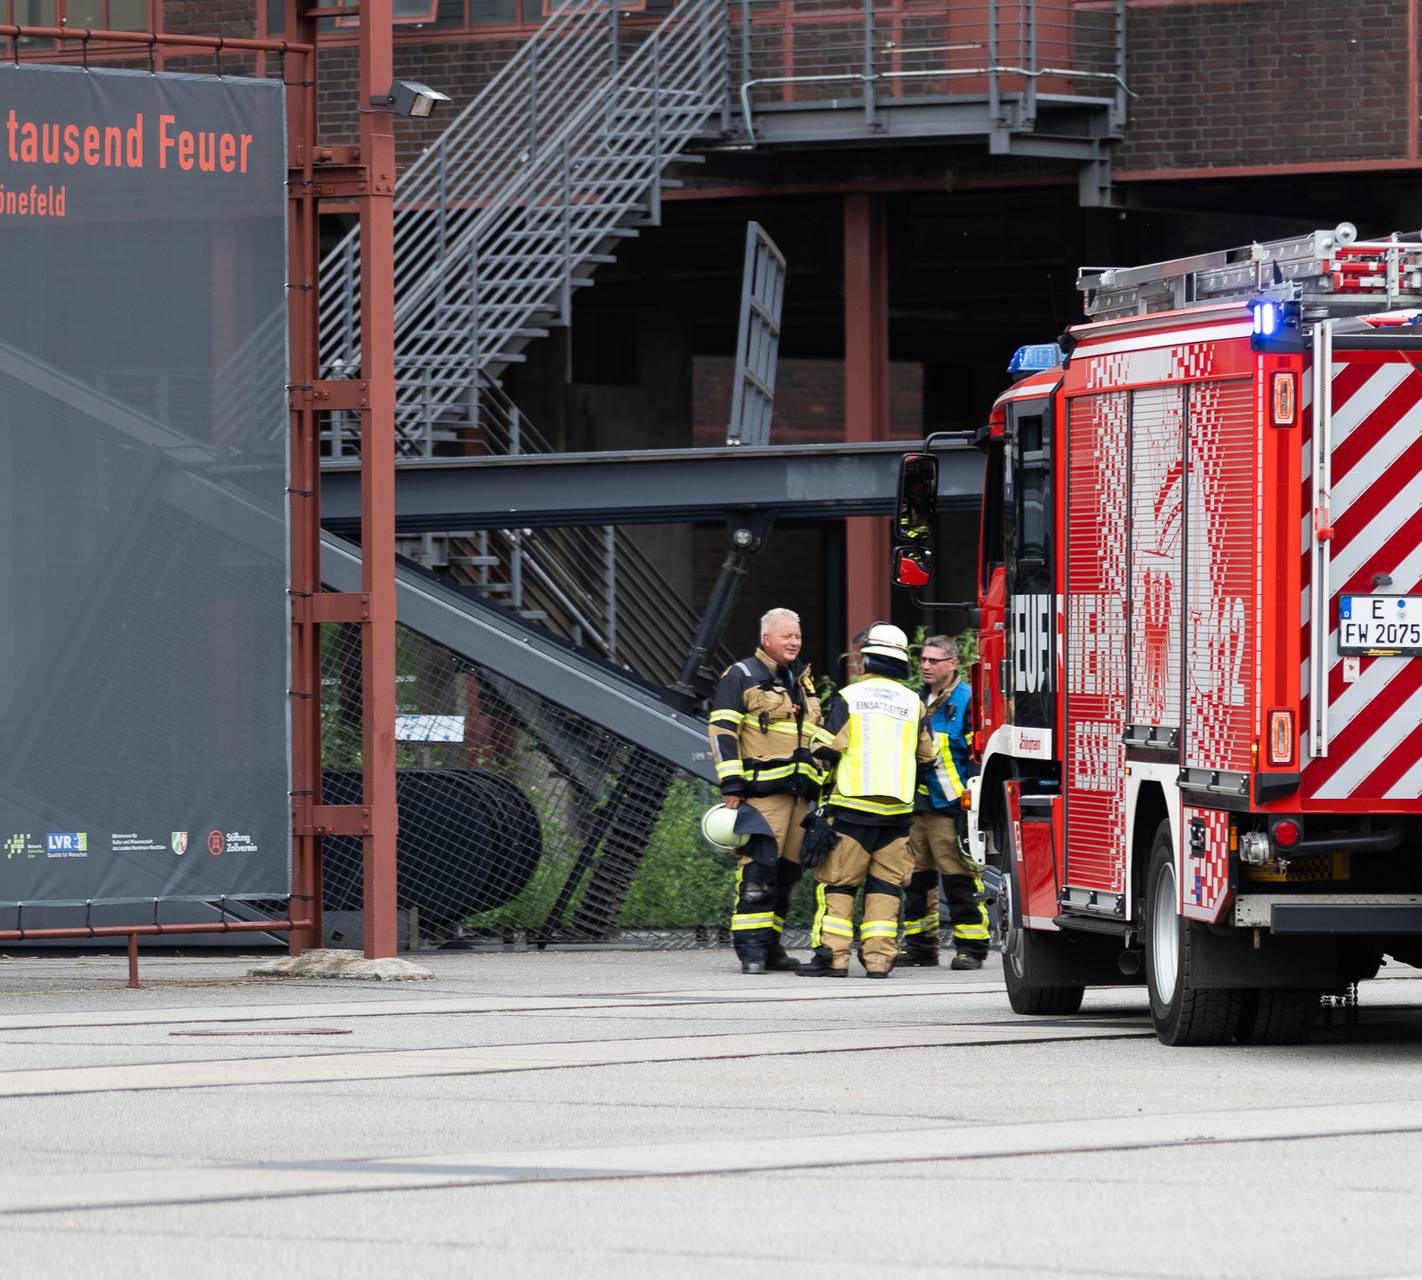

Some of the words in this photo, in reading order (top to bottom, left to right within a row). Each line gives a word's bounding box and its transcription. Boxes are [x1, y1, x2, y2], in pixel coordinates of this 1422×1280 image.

[7, 109, 143, 168] tausend
[159, 114, 253, 174] Feuer
[1372, 600, 1385, 619] E
[1346, 623, 1369, 643] FW
[1375, 623, 1420, 643] 2075
[48, 835, 72, 849] LVR
